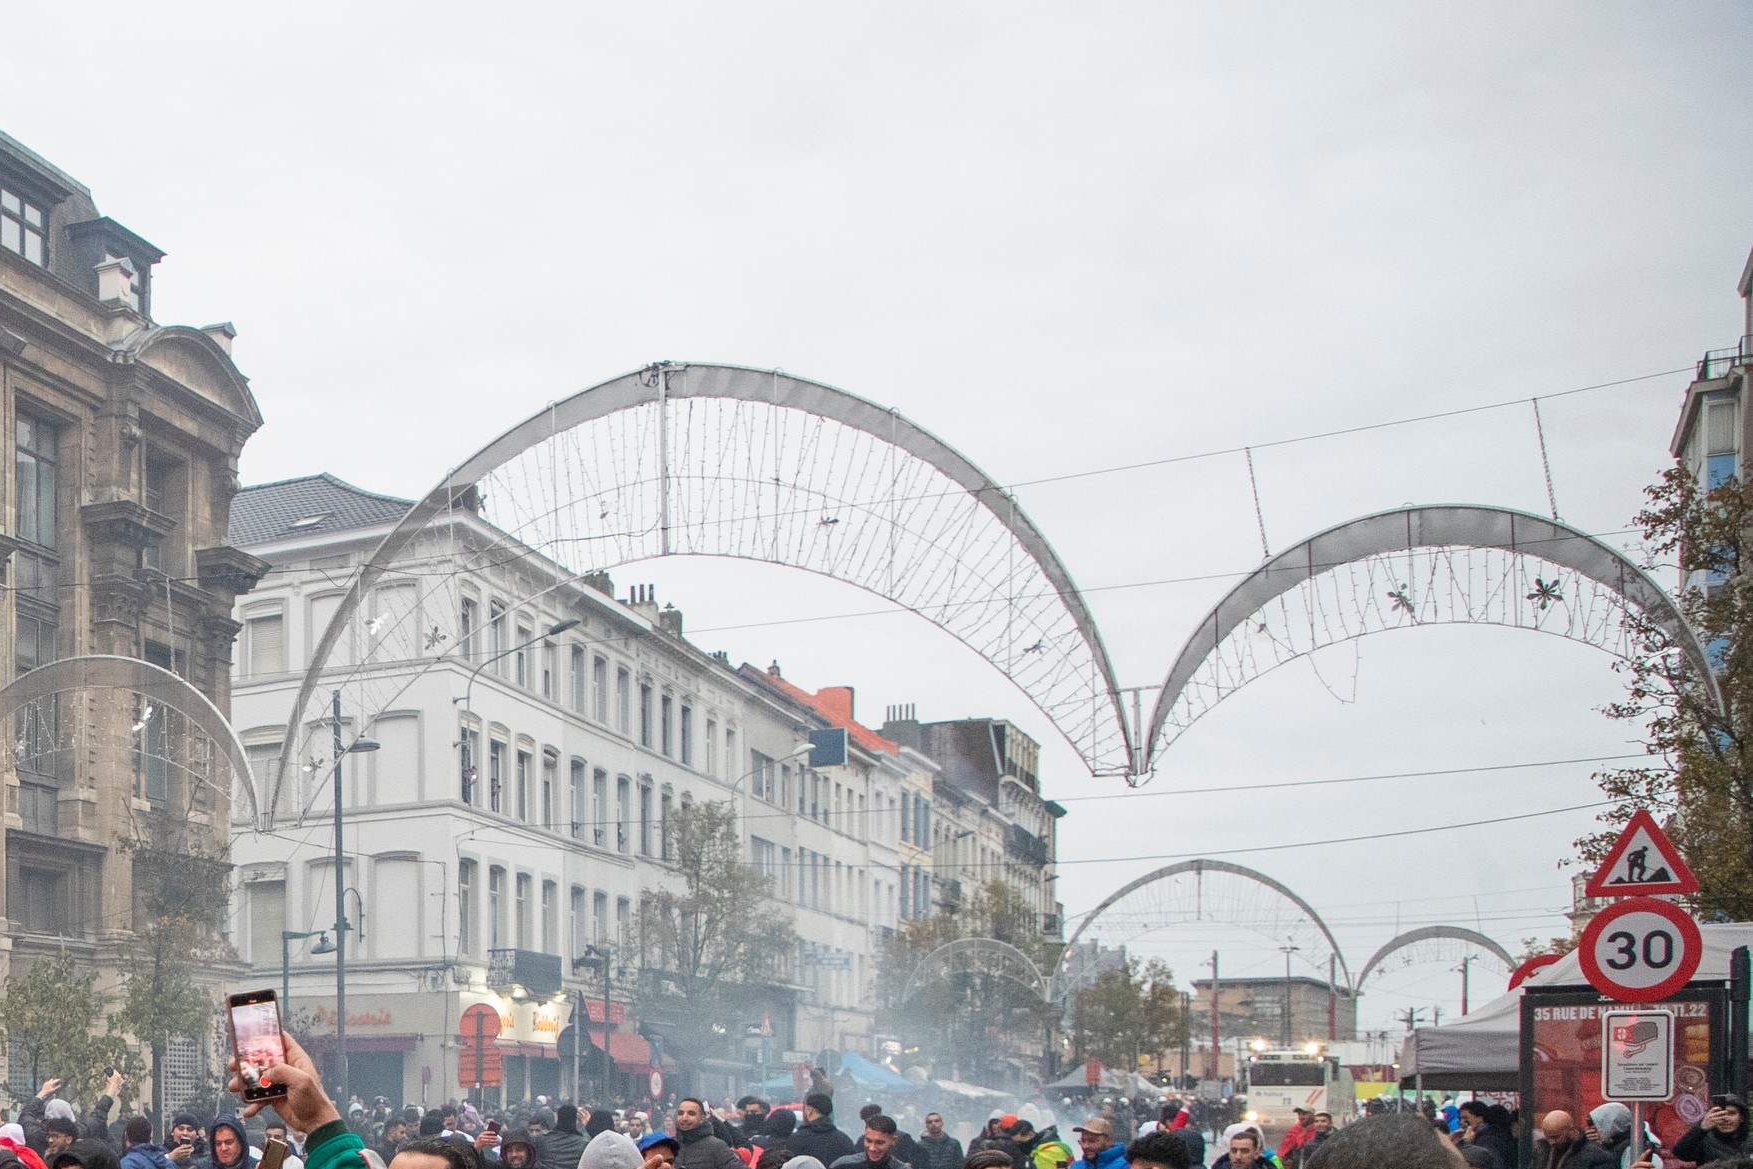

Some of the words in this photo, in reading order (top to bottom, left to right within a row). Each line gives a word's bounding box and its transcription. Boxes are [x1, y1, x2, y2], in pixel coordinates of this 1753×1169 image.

[1605, 930, 1674, 970] 30
[1534, 1007, 1550, 1020] 35
[1552, 1007, 1577, 1019] RUE
[1579, 1006, 1597, 1019] DE
